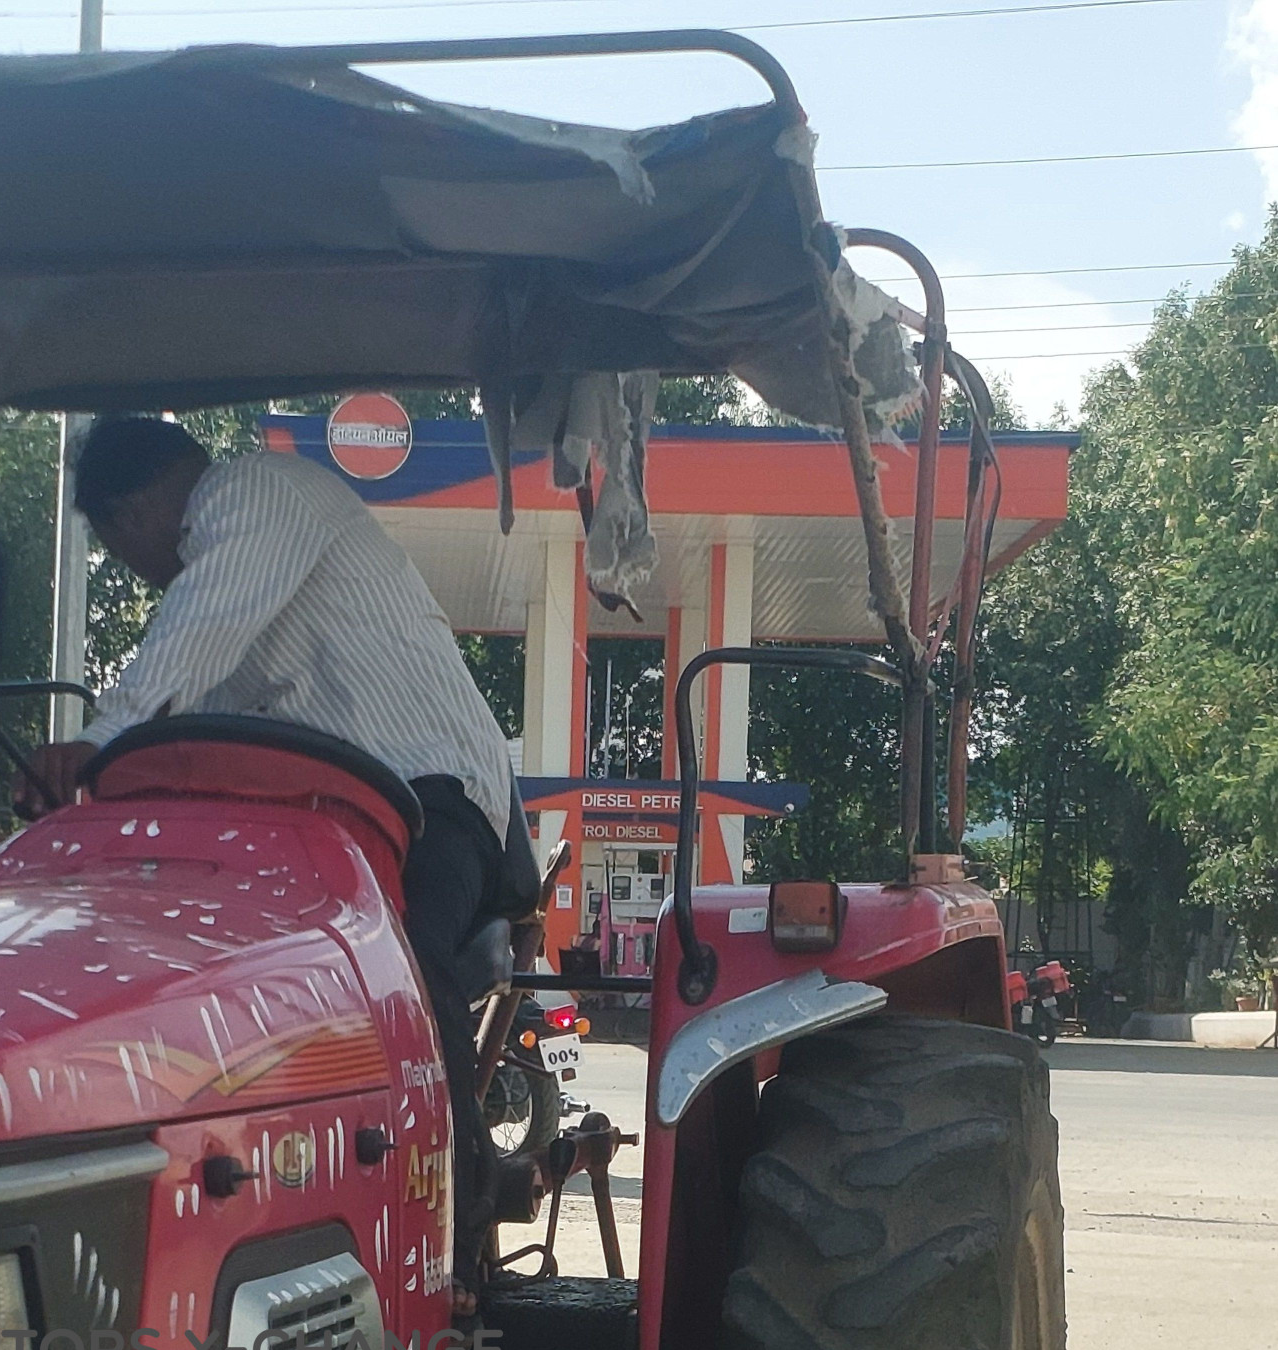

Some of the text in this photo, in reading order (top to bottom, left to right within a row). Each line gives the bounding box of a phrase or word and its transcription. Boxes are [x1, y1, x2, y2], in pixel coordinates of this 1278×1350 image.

[582, 793, 704, 809] DIESEL PETRL
[582, 824, 663, 839] ROL DIESEL
